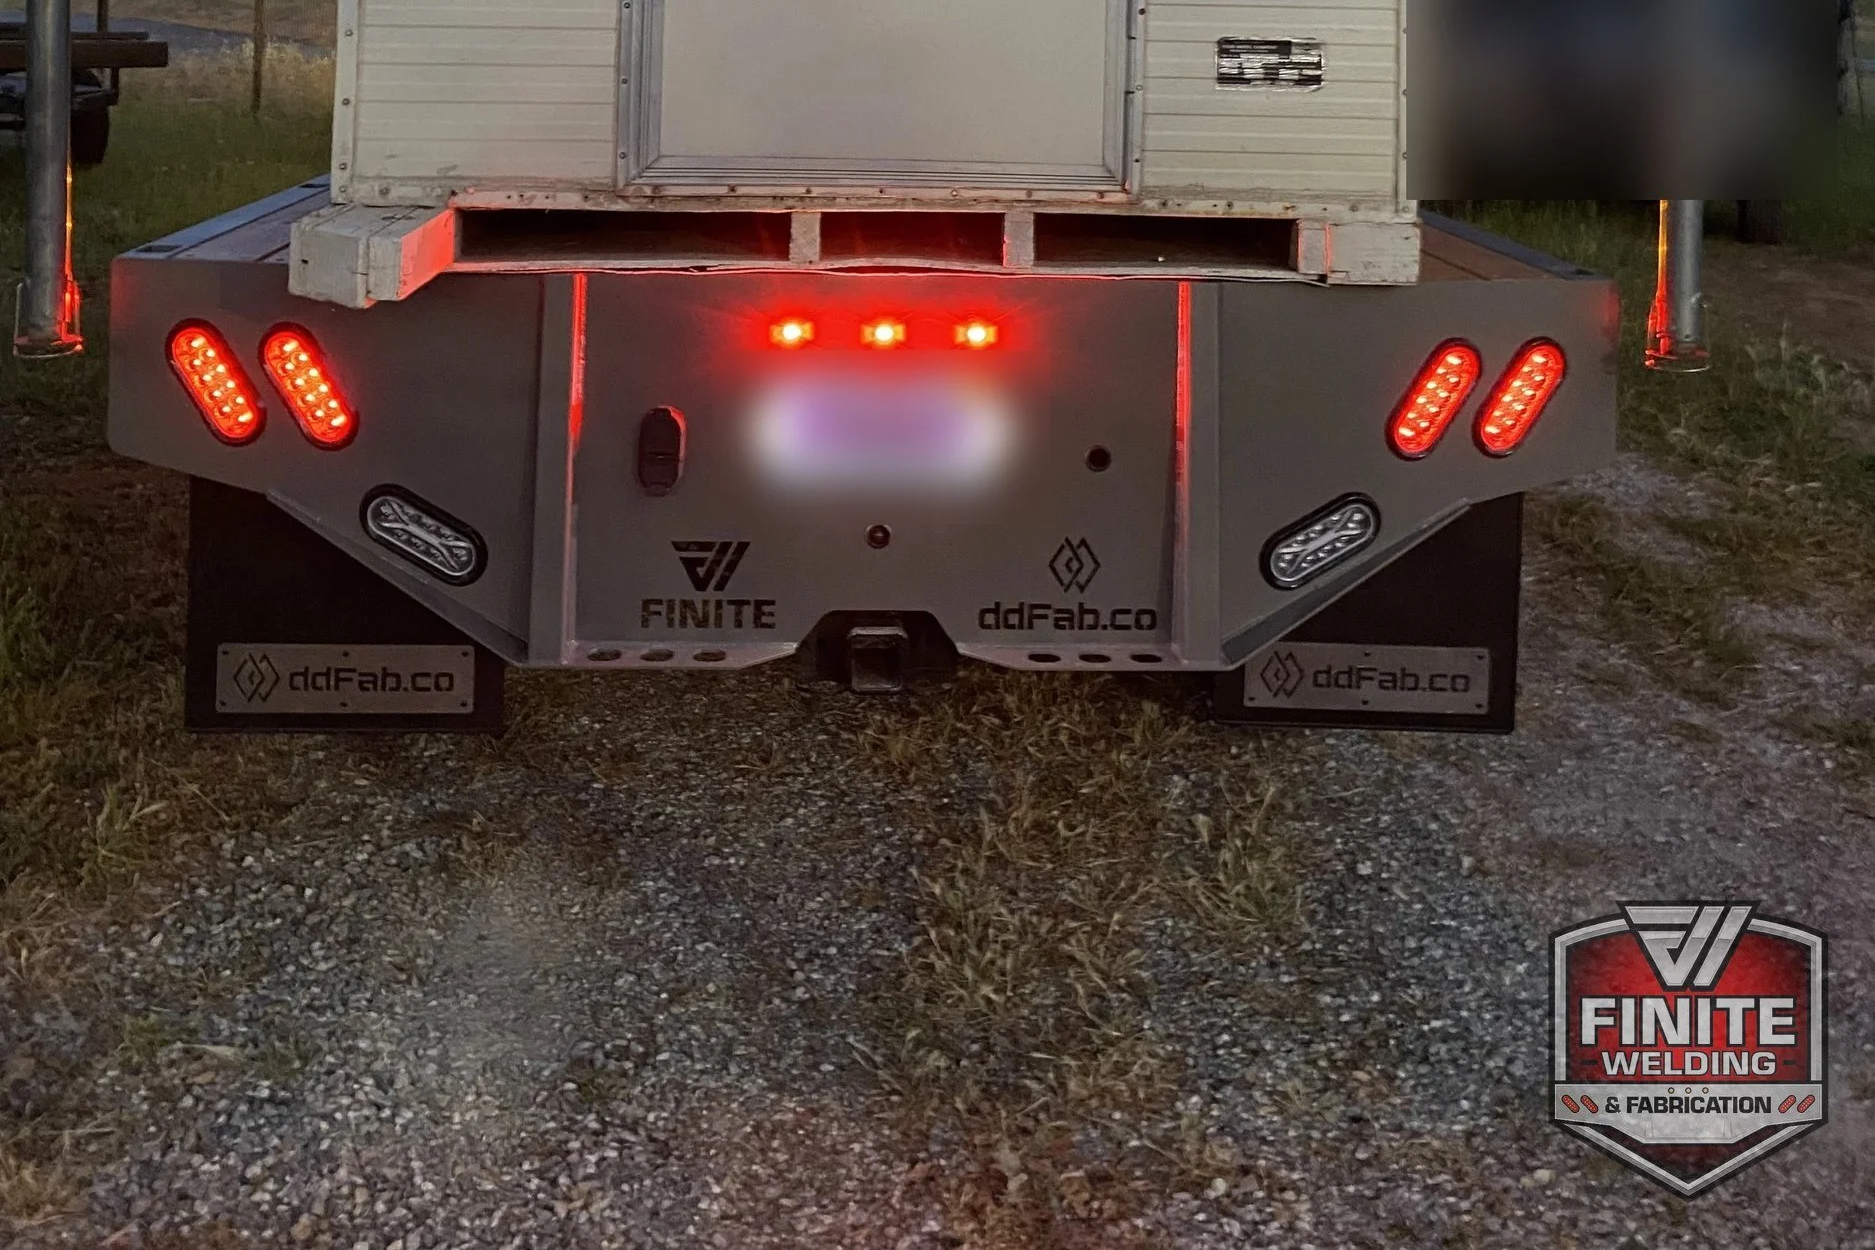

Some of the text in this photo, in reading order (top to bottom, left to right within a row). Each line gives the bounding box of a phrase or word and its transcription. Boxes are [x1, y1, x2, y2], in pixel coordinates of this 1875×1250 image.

[640, 598, 777, 629] FINITE
[978, 601, 1157, 631] ddFab.co
[288, 666, 455, 693] ddFab.co
[1312, 664, 1471, 693] ddFab.co
